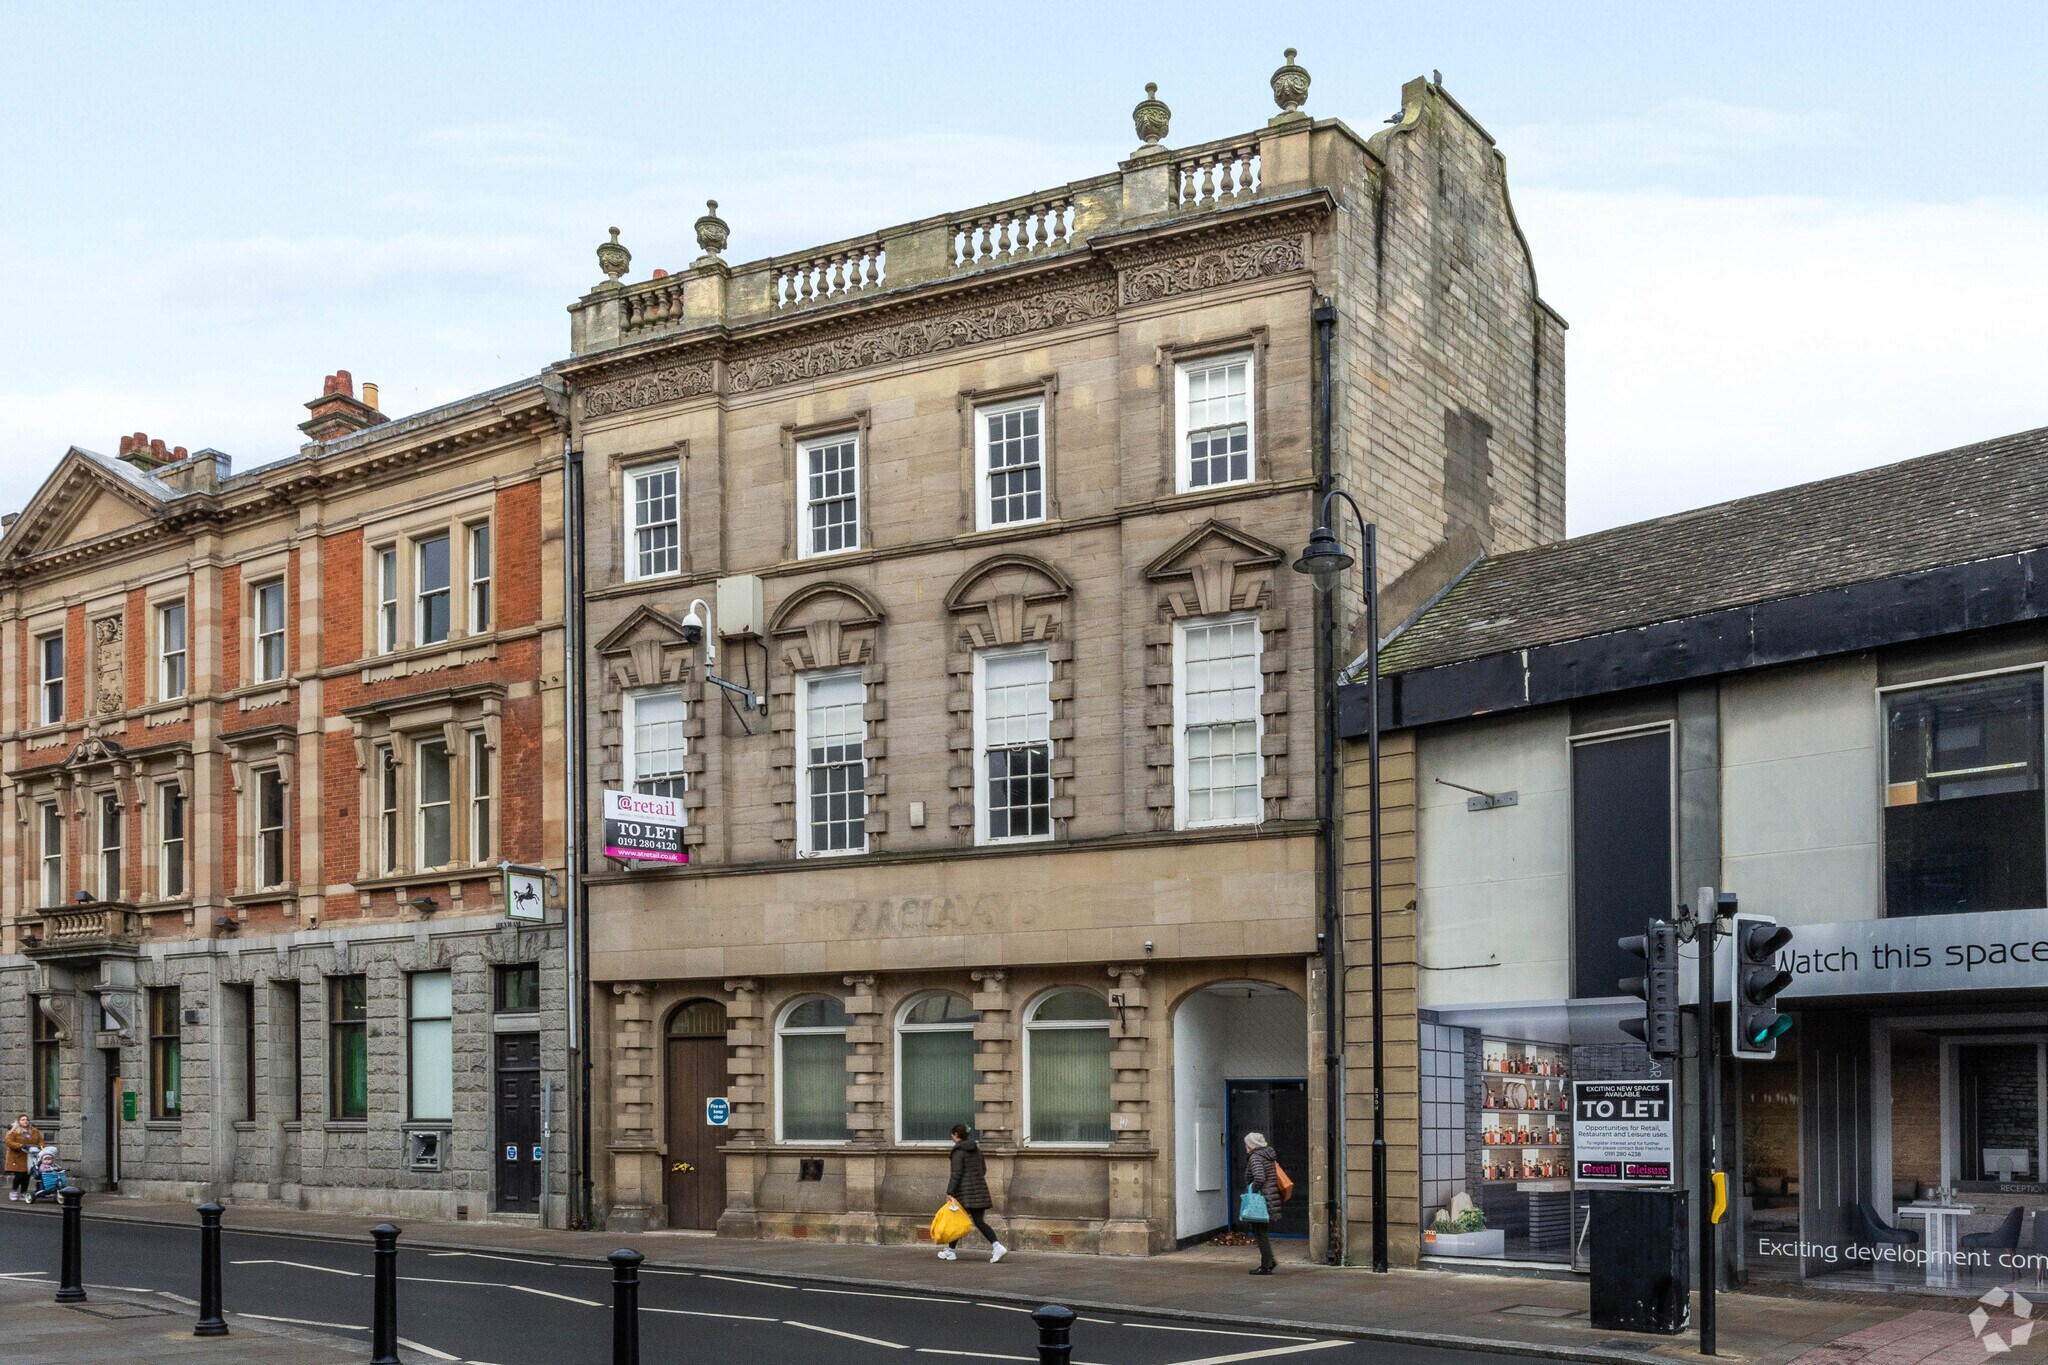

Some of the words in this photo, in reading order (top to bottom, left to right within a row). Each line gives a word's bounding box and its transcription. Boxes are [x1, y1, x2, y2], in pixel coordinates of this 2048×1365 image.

[617, 795, 676, 817] @retail
[617, 822, 641, 837] TO
[645, 825, 677, 841] LET
[618, 837, 638, 847] 0191
[639, 839, 655, 849] 280
[656, 841, 677, 851] 4120
[617, 849, 678, 861] www.atretail.co.uk
[1778, 945, 1858, 974] Watch
[1871, 942, 1932, 970] this
[1945, 940, 2048, 973] space
[1582, 1100, 1614, 1118] TO
[1621, 1100, 1664, 1118] LET
[1585, 1124, 1629, 1132] Opportunities
[1640, 1124, 1660, 1132] Retail,
[1758, 1238, 1838, 1263] Exciting
[1844, 1242, 1992, 1267] development
[1998, 1253, 2048, 1270] com
